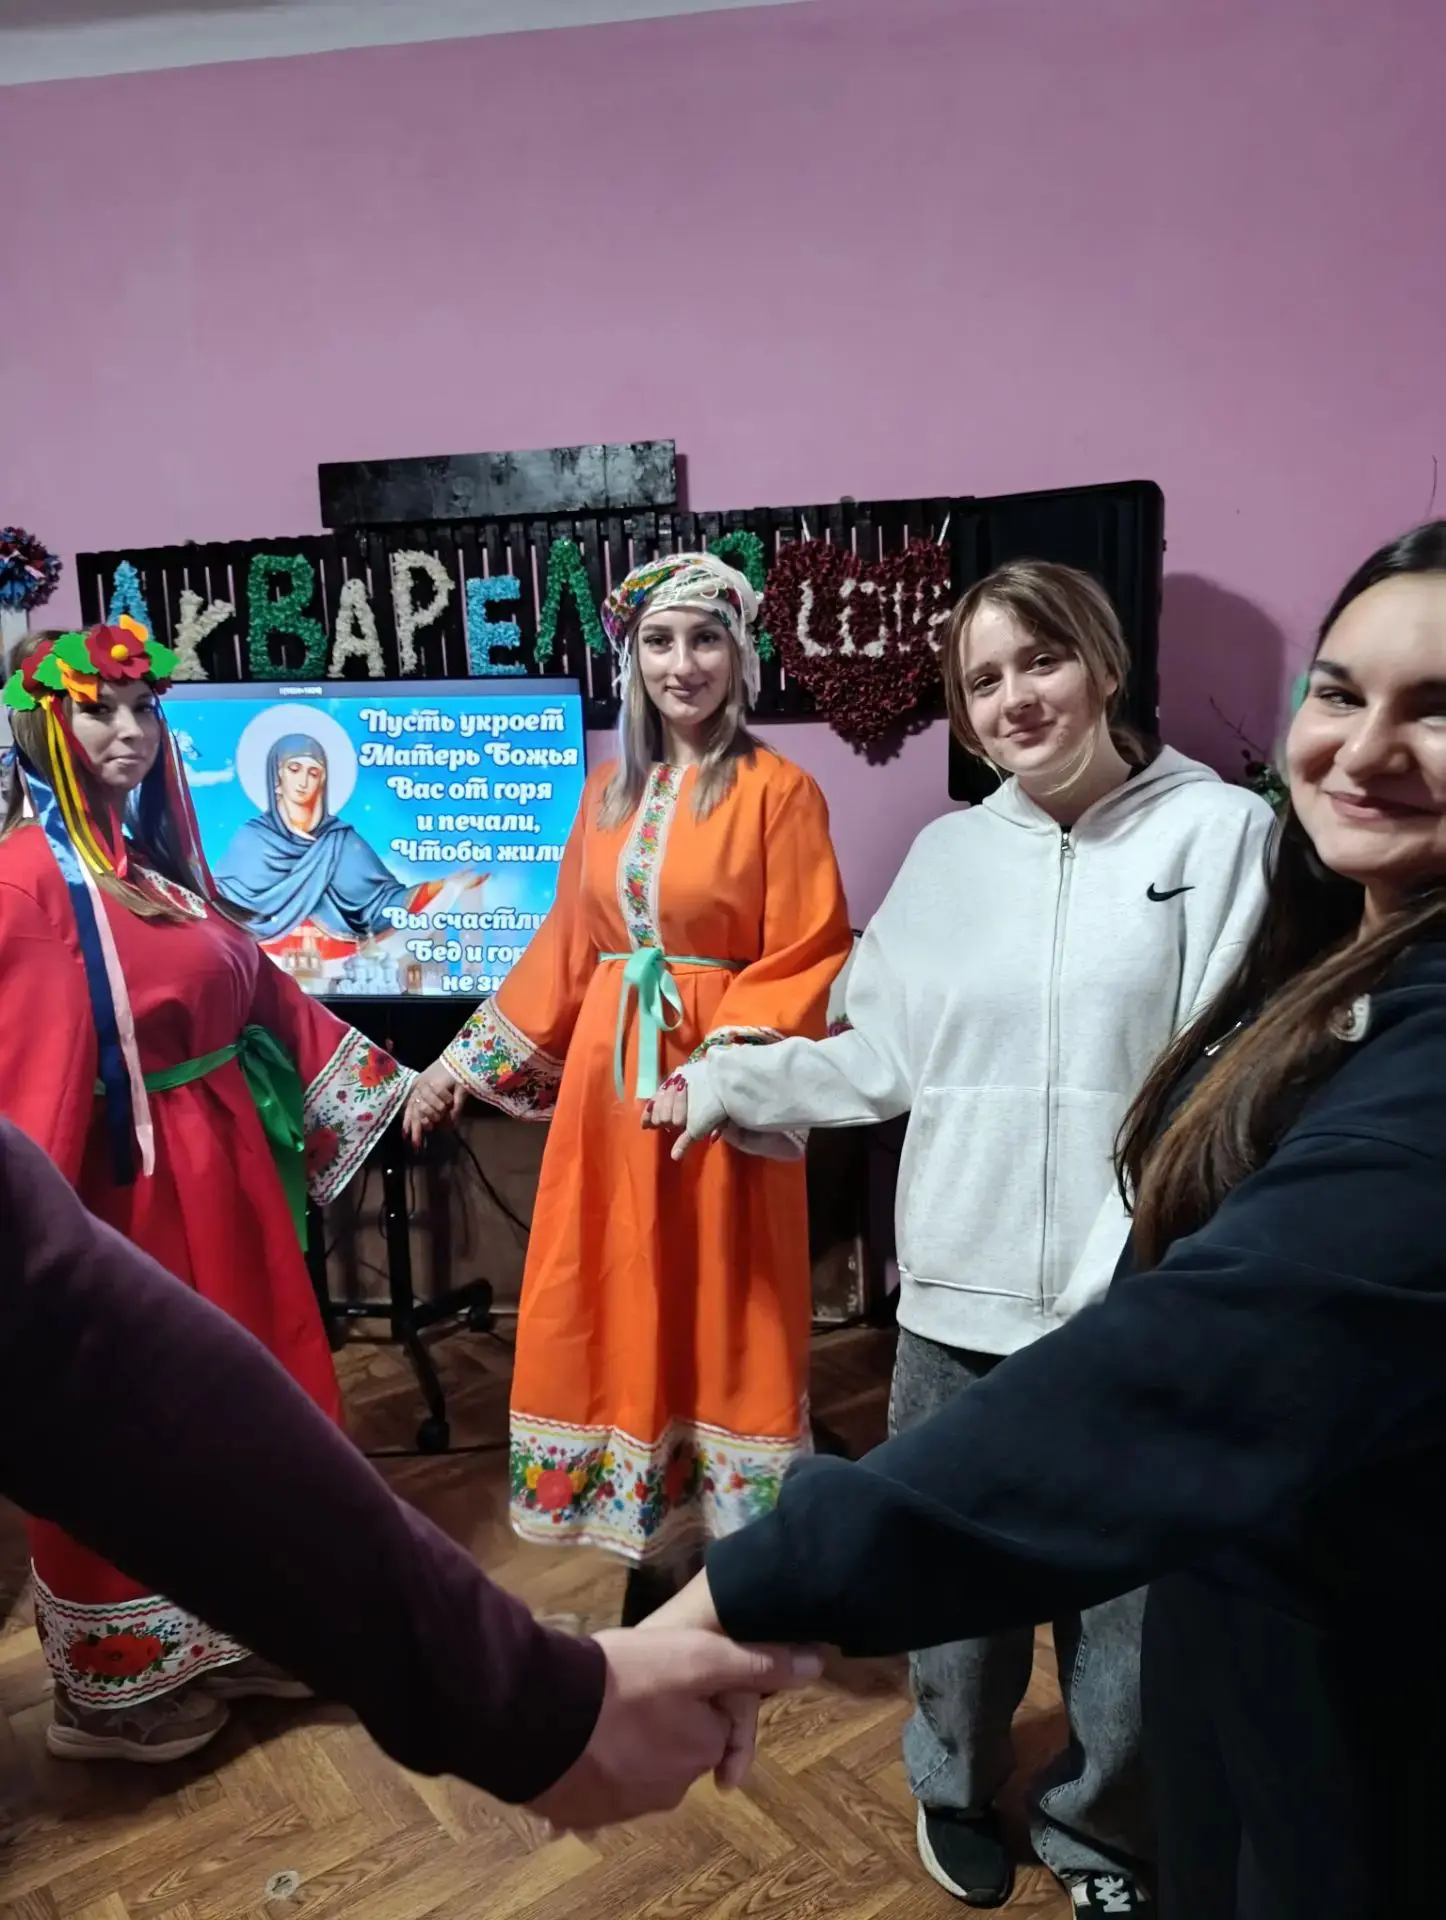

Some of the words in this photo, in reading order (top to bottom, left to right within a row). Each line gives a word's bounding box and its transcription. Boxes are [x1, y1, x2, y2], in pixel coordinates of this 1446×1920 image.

[359, 708, 455, 738] Пусть
[459, 707, 565, 737] укроет
[358, 742, 480, 771] Матерь
[484, 742, 578, 767] Божья
[386, 776, 444, 800] Вас
[447, 776, 489, 800] от
[493, 782, 553, 805] горя
[417, 814, 433, 832] и
[438, 814, 541, 833] печали,
[390, 839, 493, 862] Чтобы
[382, 907, 430, 930] Вы
[433, 908, 547, 930] счастли
[406, 939, 462, 963] Бед
[466, 946, 482, 962] и
[487, 945, 527, 965] гор
[442, 975, 474, 992] не
